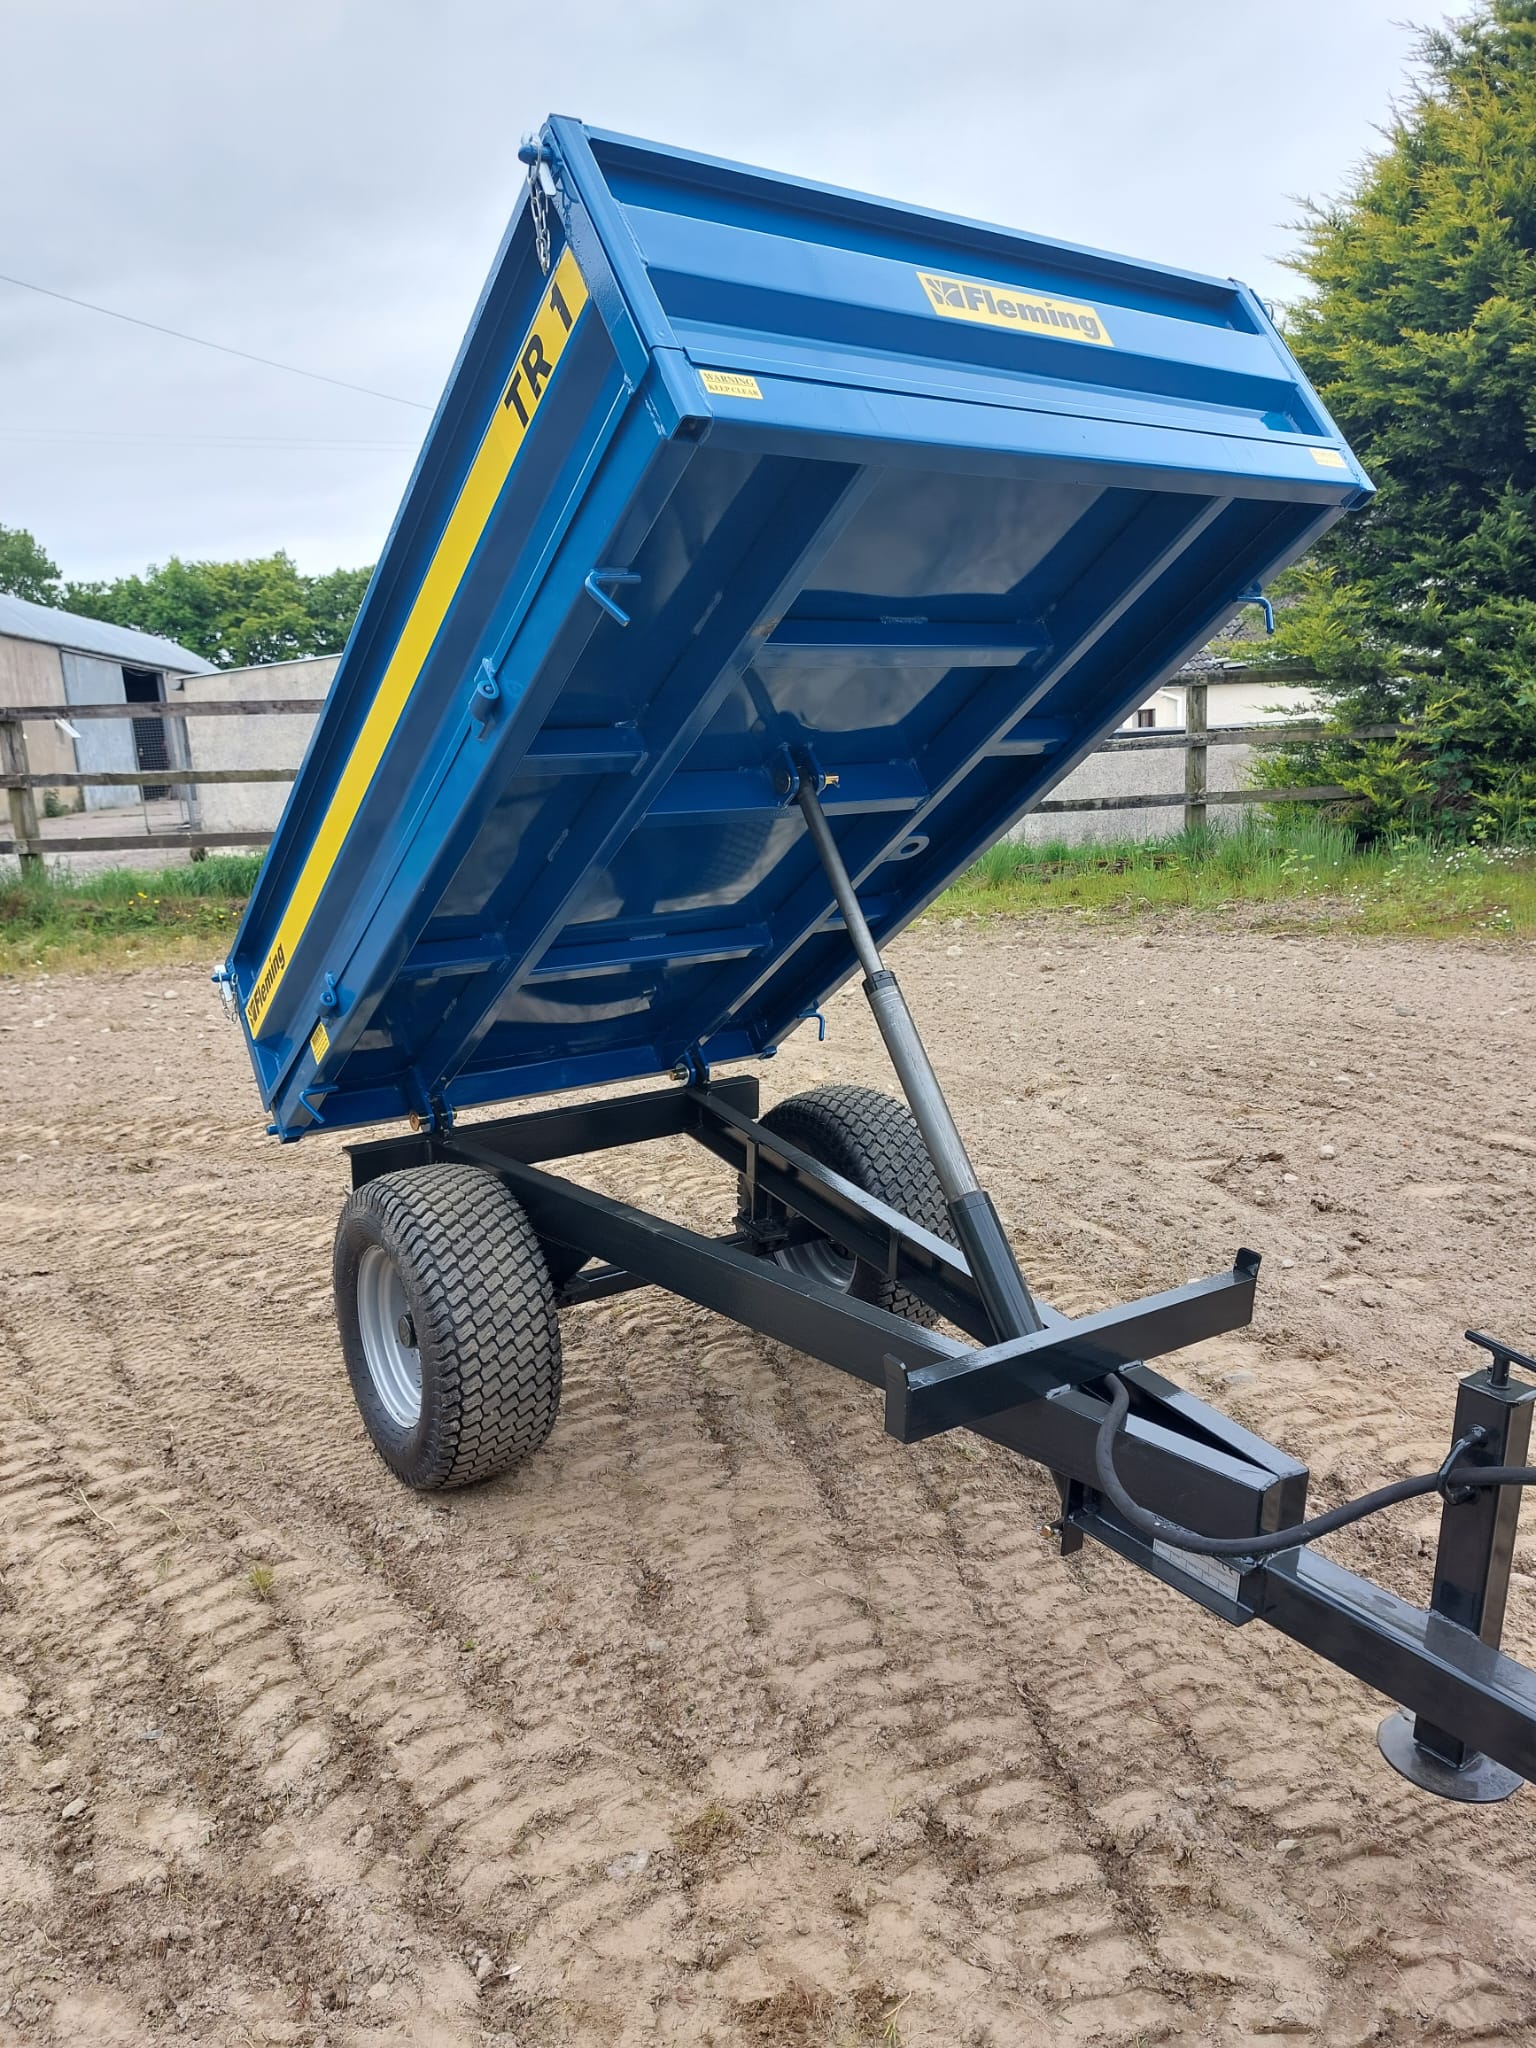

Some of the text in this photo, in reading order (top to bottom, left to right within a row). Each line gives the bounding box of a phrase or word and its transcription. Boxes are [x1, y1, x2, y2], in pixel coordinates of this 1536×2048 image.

[962, 284, 1100, 339] Fleming
[504, 281, 573, 428] TR 1
[703, 373, 754, 386] WARNING
[708, 384, 730, 393] KEEP
[253, 943, 286, 1016] Fleming
